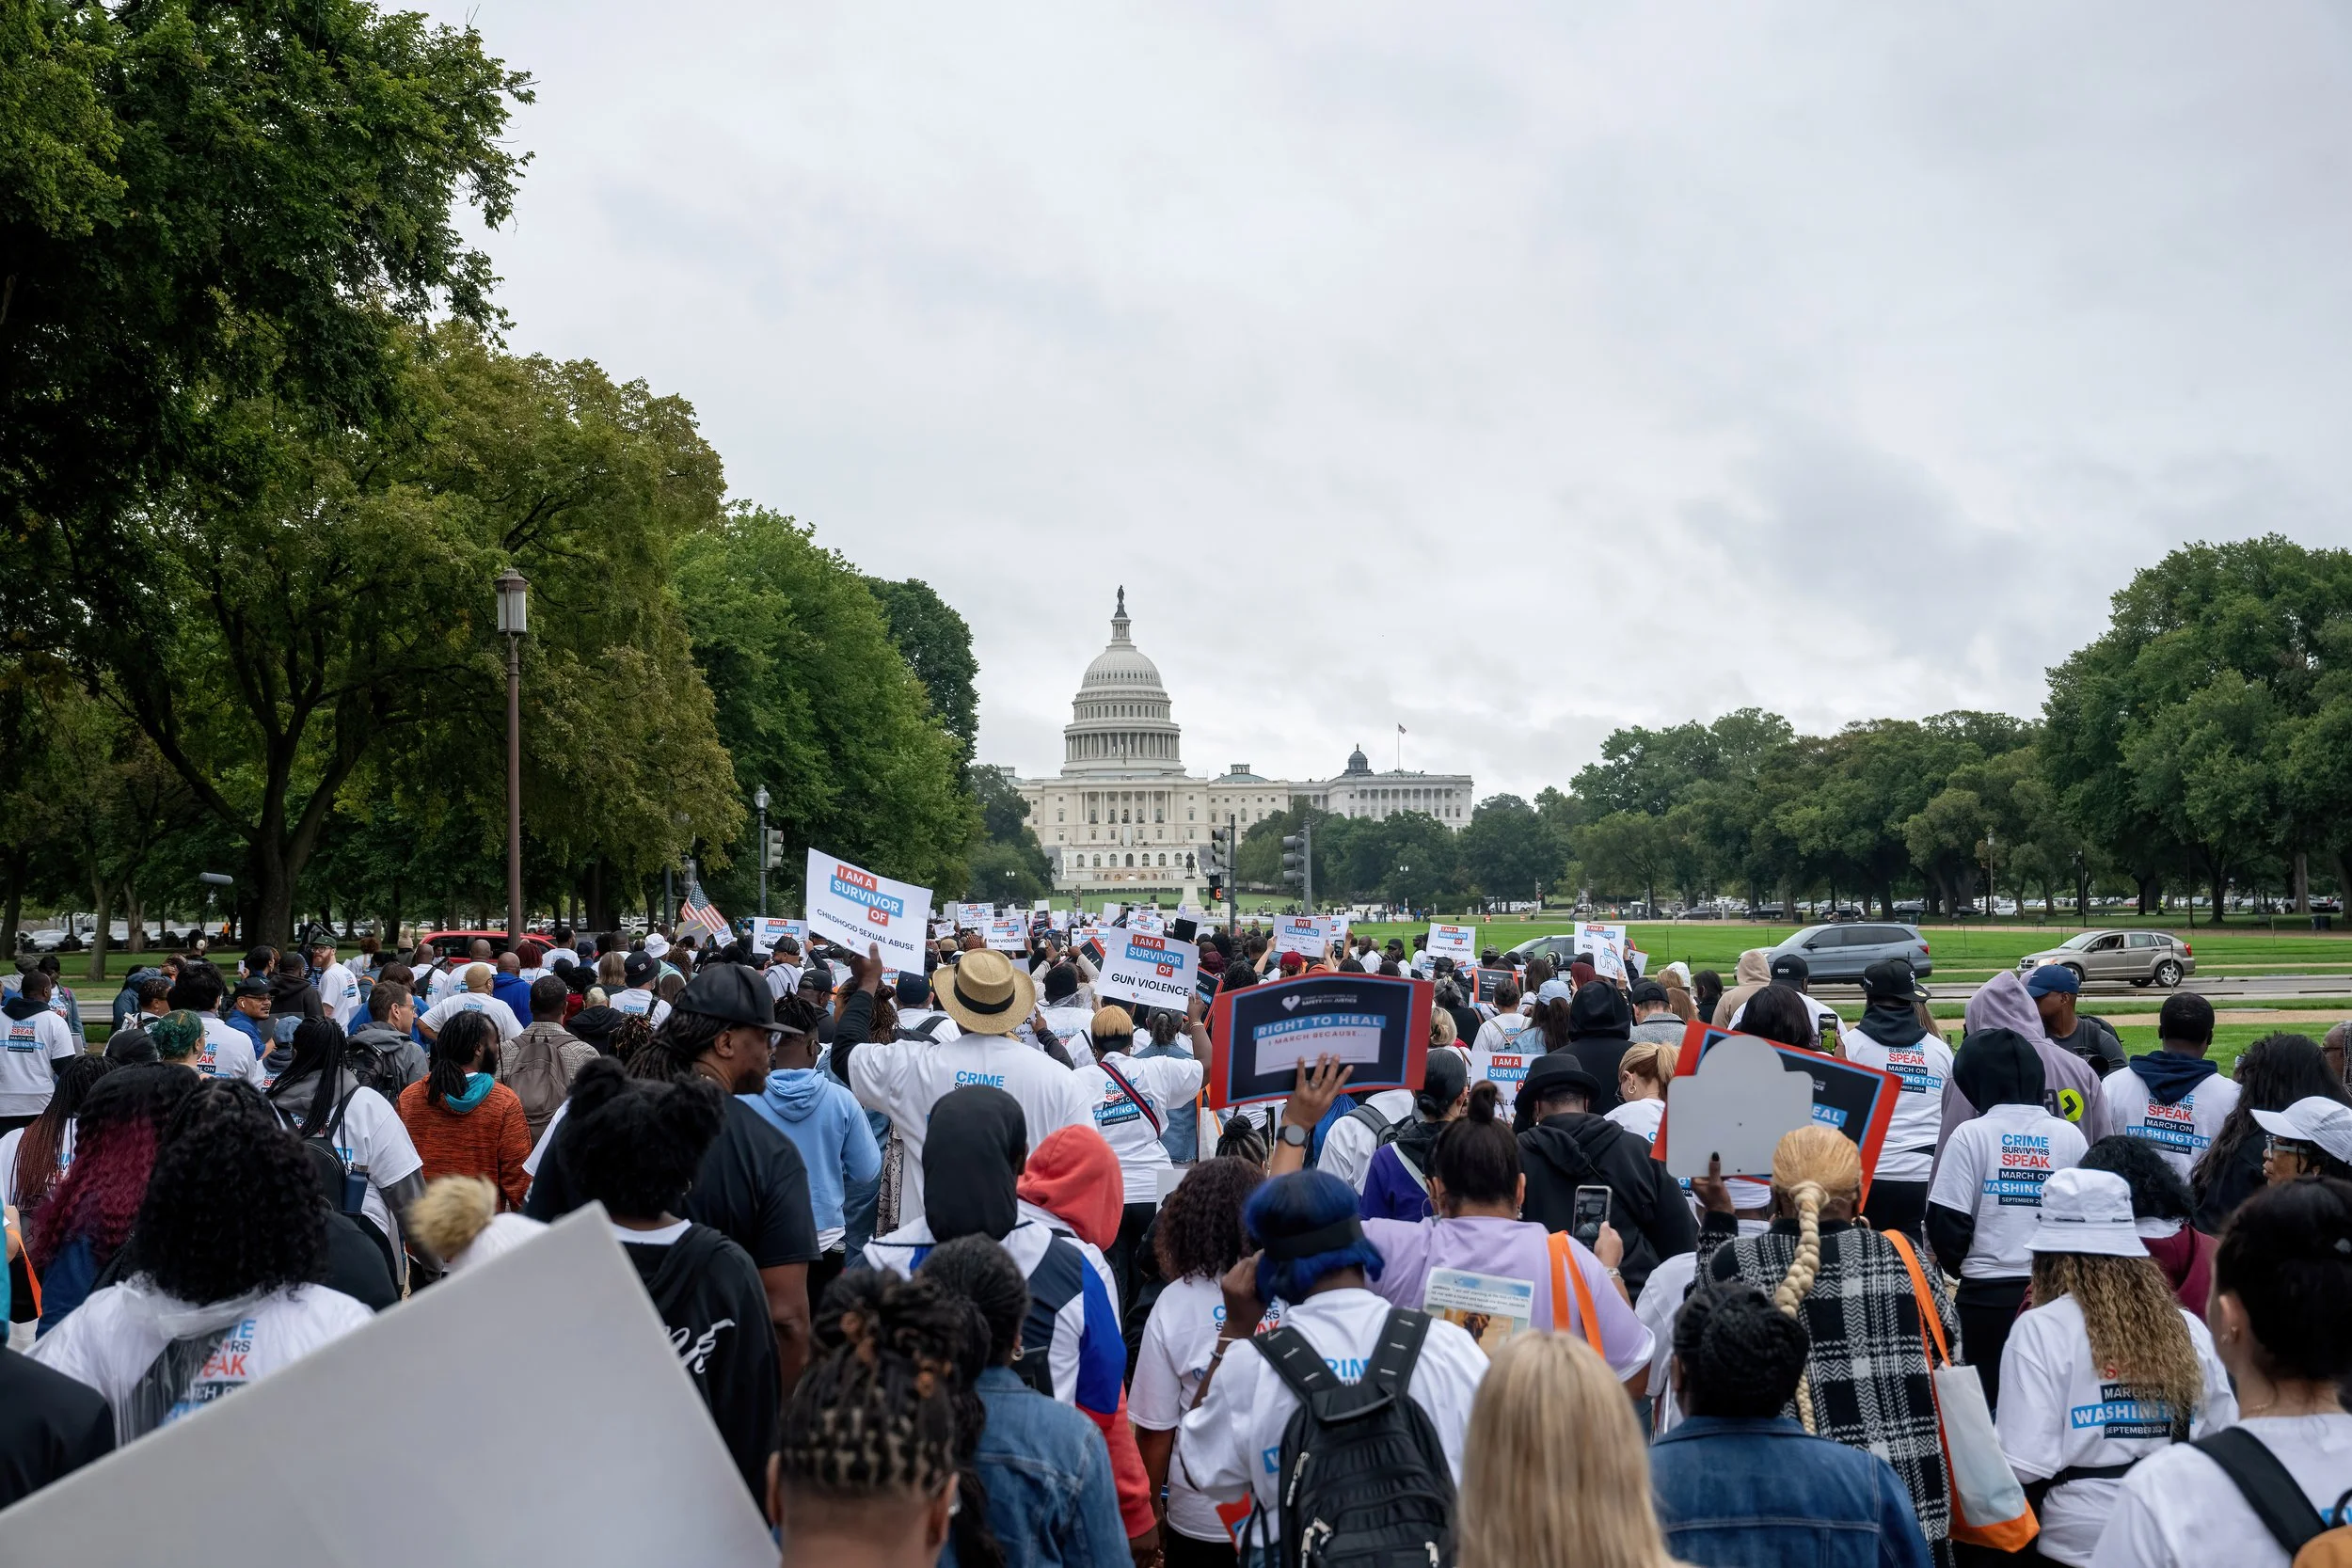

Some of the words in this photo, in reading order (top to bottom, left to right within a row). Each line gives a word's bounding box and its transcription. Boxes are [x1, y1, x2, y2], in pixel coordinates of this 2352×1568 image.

[840, 867, 845, 878] I
[846, 869, 864, 885] AM
[865, 878, 873, 889] A
[834, 879, 899, 912] SURVIVOR
[870, 910, 887, 922] OF
[817, 909, 858, 933] CHILDHOOD
[859, 927, 887, 944] SEXUAL
[888, 939, 914, 951] ABUSE
[1286, 927, 1318, 936] DEMAND
[1139, 938, 1153, 947] AM
[1154, 941, 1162, 949] A
[1129, 946, 1181, 965] SURVIVOR
[1159, 965, 1171, 974] OF
[1111, 973, 1136, 986] GUN
[1138, 977, 1189, 997] VIOLENCE
[1258, 1019, 1306, 1037] RIGHT
[1311, 1016, 1332, 1026] TO
[1339, 1015, 1381, 1025] HEAL
[1274, 1035, 1309, 1045] MARCH
[1888, 1053, 1925, 1065] SPEAK
[1489, 1069, 1528, 1078] SURVIV
[1887, 1065, 1914, 1073] MARCH
[956, 1070, 1005, 1087] CRIME
[1812, 1105, 1840, 1122] EAL
[2148, 1105, 2192, 1121] SPEAK
[2146, 1119, 2177, 1131] MARCH
[2179, 1124, 2193, 1132] ON
[2001, 1133, 2049, 1148] CRIME
[2128, 1128, 2209, 1148] WASHINGTON
[2002, 1153, 2051, 1168] SPEAK
[2001, 1171, 2034, 1180] MARCH
[1982, 1181, 2042, 1194] WASHING
[203, 1354, 247, 1378] EAK
[2106, 1425, 2153, 1435] SEPTEMBER
